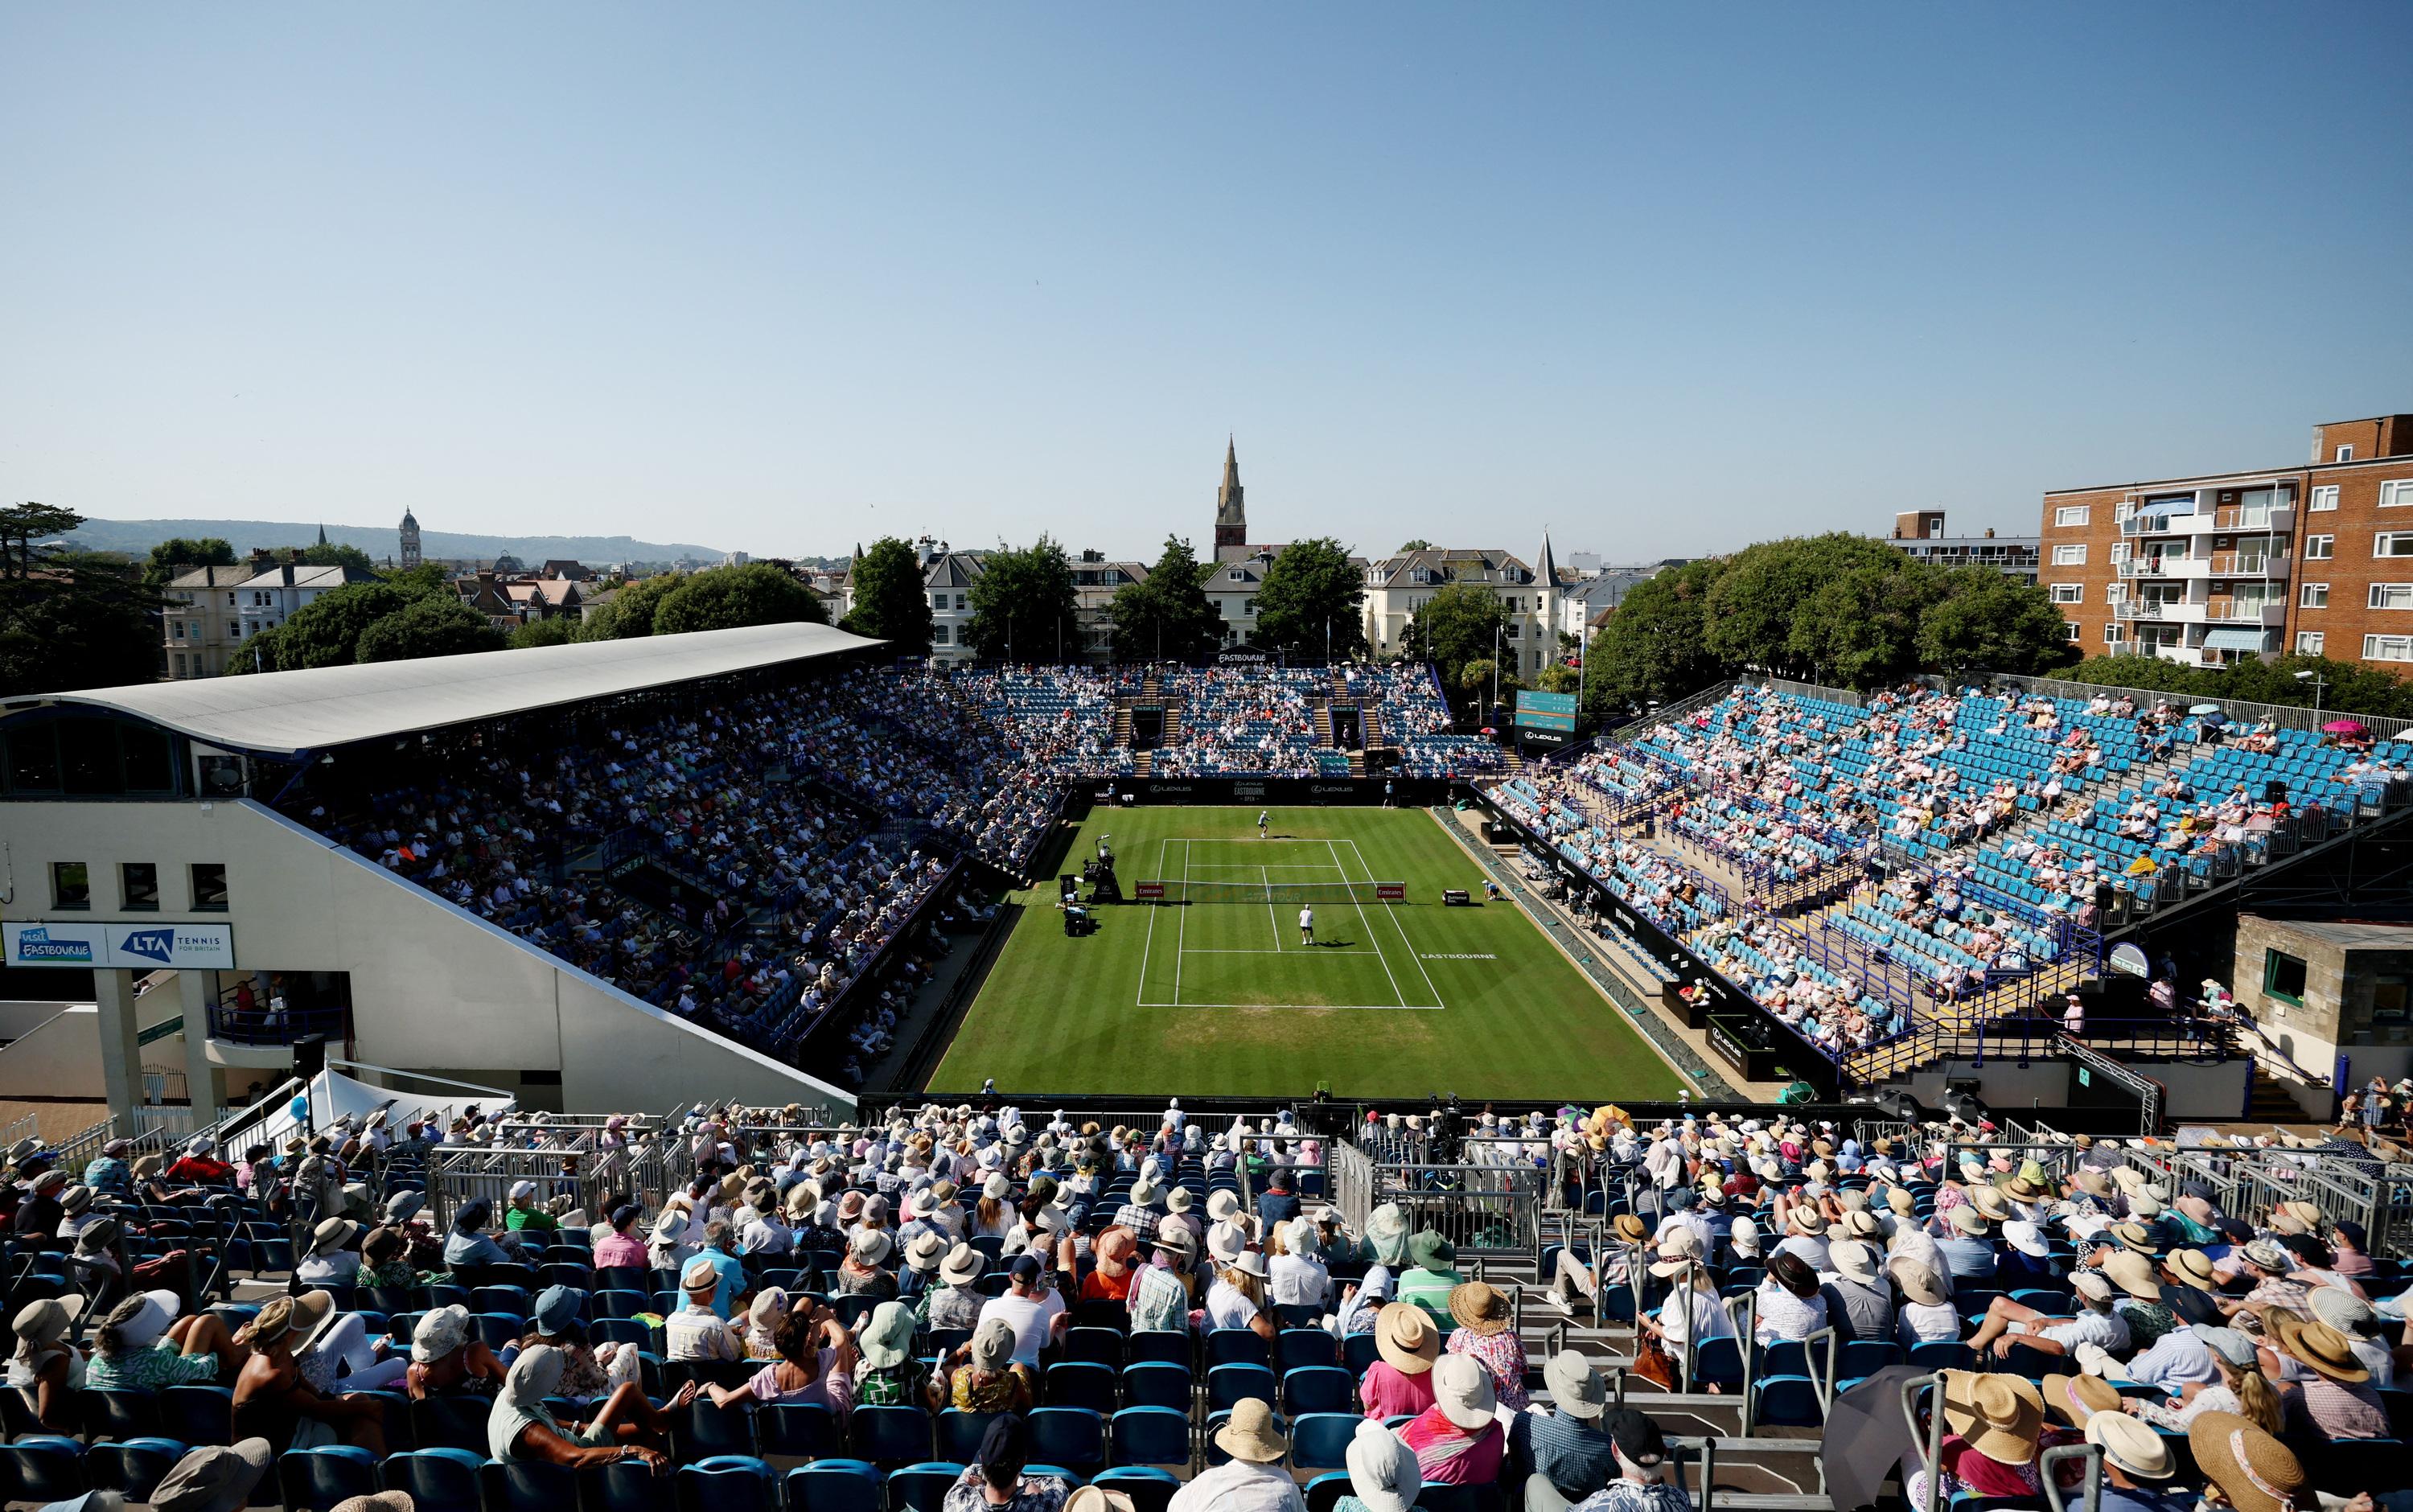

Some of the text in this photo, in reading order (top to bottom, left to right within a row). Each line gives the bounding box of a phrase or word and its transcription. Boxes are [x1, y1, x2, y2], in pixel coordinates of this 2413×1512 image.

[1219, 654, 1266, 663] EASTBOURNE
[1535, 733, 1562, 742] LEXUS
[1234, 787, 1265, 795] EASTBOURNE
[1271, 893, 1301, 902] TOUR
[23, 930, 47, 942] visit
[23, 944, 88, 956] EASTBOURNE
[132, 936, 220, 955] LTA TENNIS
[1710, 983, 1727, 999] LEXUS
[1720, 1035, 1741, 1058] LEXUS
